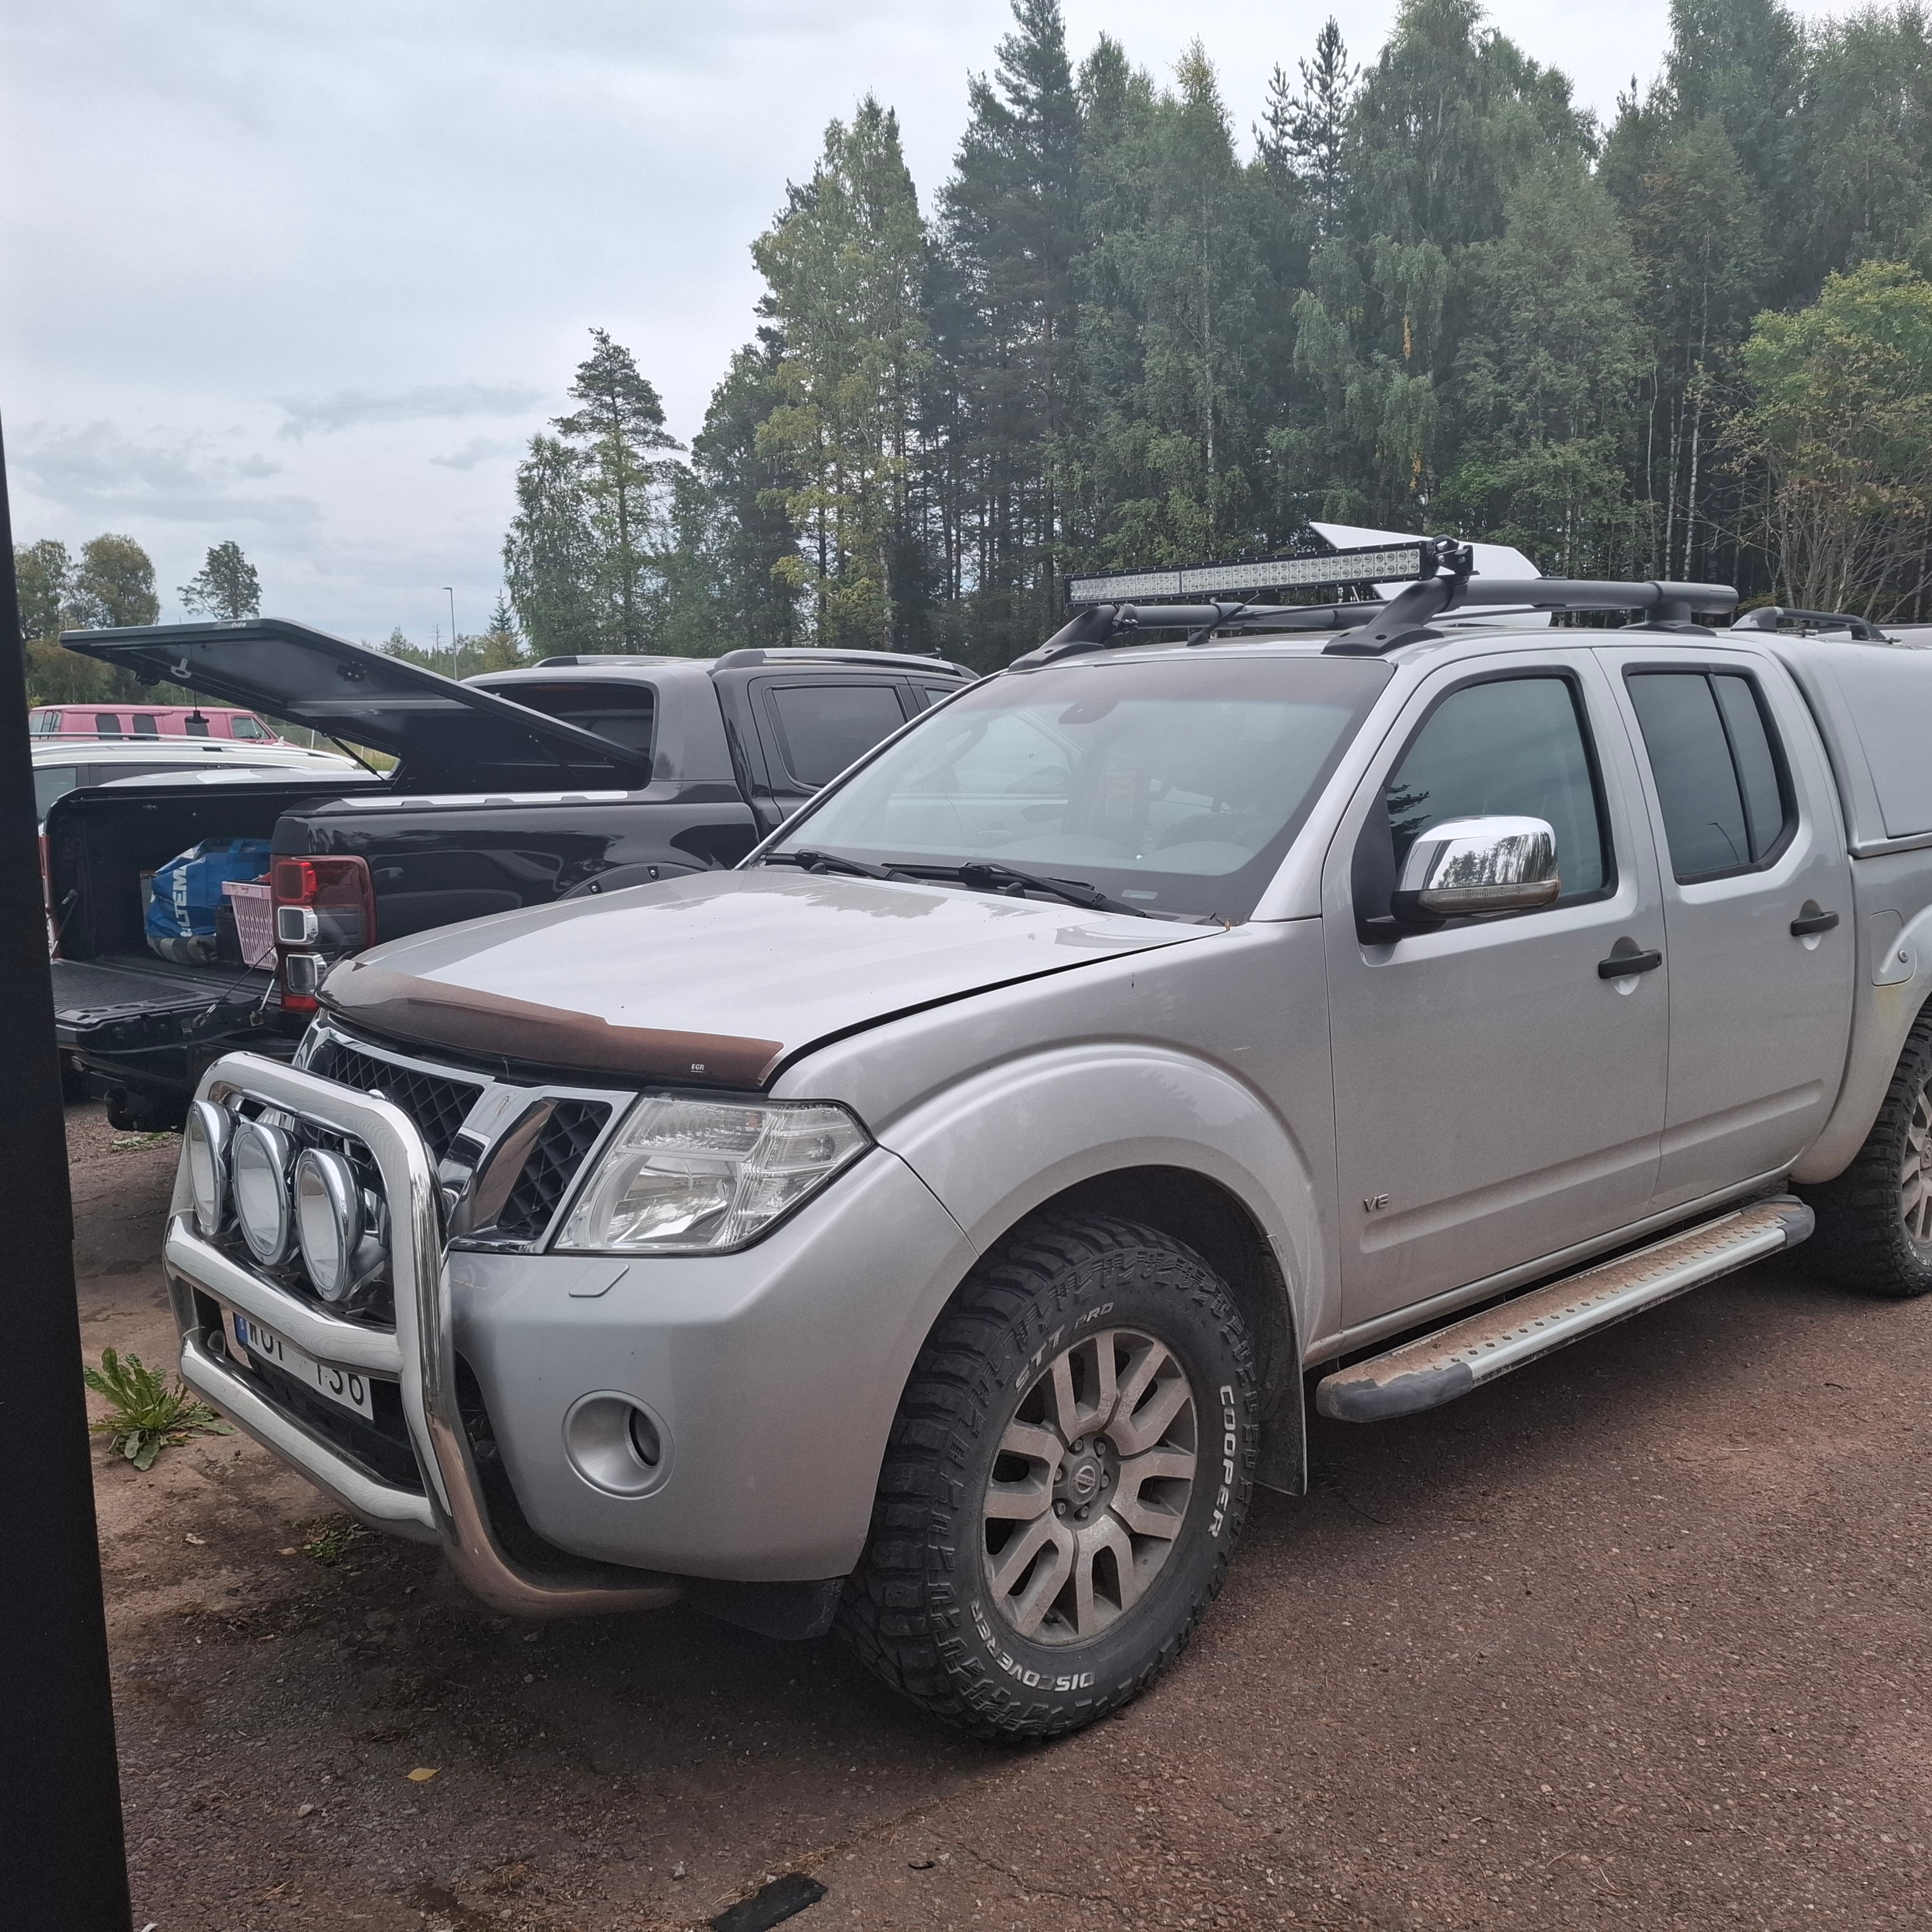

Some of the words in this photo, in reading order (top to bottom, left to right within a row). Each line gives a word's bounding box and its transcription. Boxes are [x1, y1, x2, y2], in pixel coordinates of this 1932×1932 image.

[1015, 1324, 1065, 1395] STT
[1074, 1302, 1114, 1330] PRO
[1207, 1385, 1236, 1538] COOPER
[970, 1597, 1096, 1692] DISCOVERER
